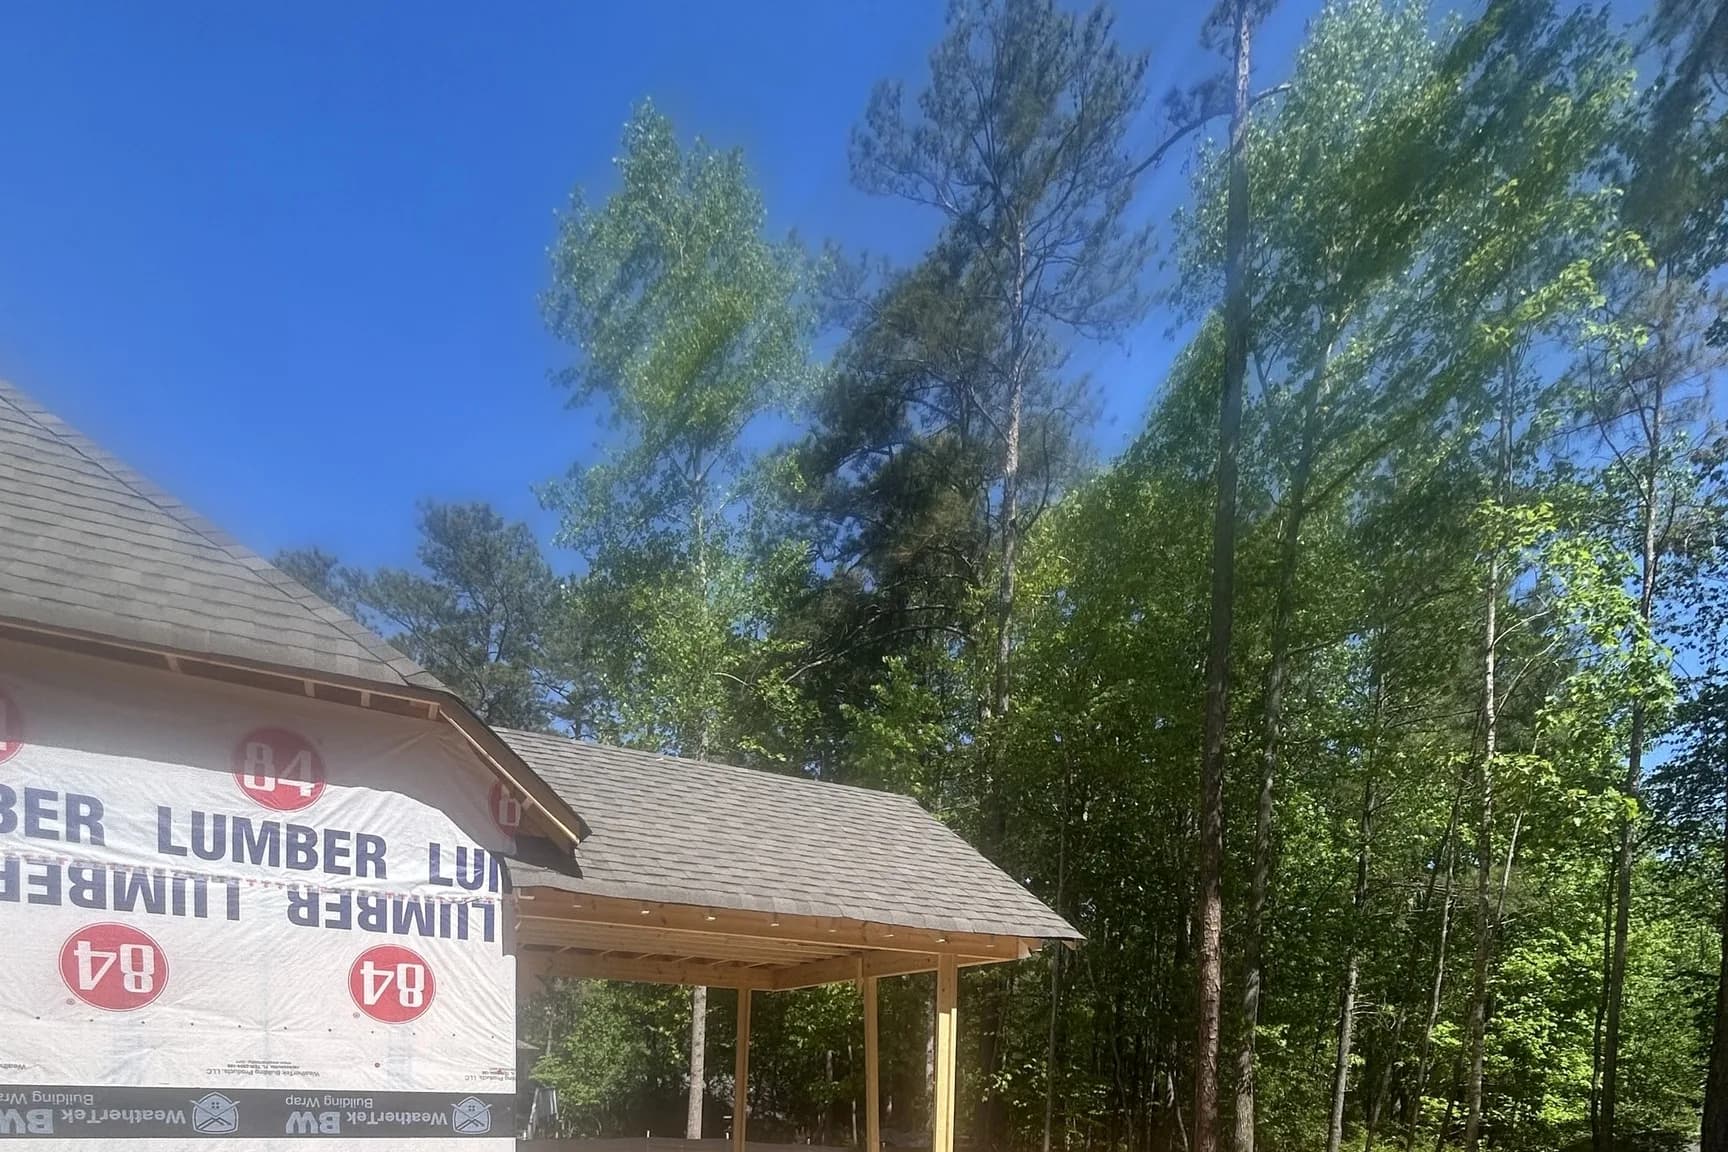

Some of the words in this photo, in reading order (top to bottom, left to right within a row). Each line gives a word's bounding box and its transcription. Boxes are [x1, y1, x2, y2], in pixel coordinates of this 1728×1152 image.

[244, 741, 315, 797] 84
[157, 805, 388, 880] LUMBER
[429, 842, 499, 893] LU
[287, 884, 495, 943] LUMBER
[74, 941, 155, 993] 84
[360, 960, 425, 1007] 84
[32, 1091, 94, 1106] Building
[285, 1094, 320, 1108] Wrap
[323, 1095, 373, 1109] Building
[61, 1108, 187, 1124] WeatherTek
[285, 1111, 341, 1134] BW
[346, 1111, 448, 1126] WeatherTek
